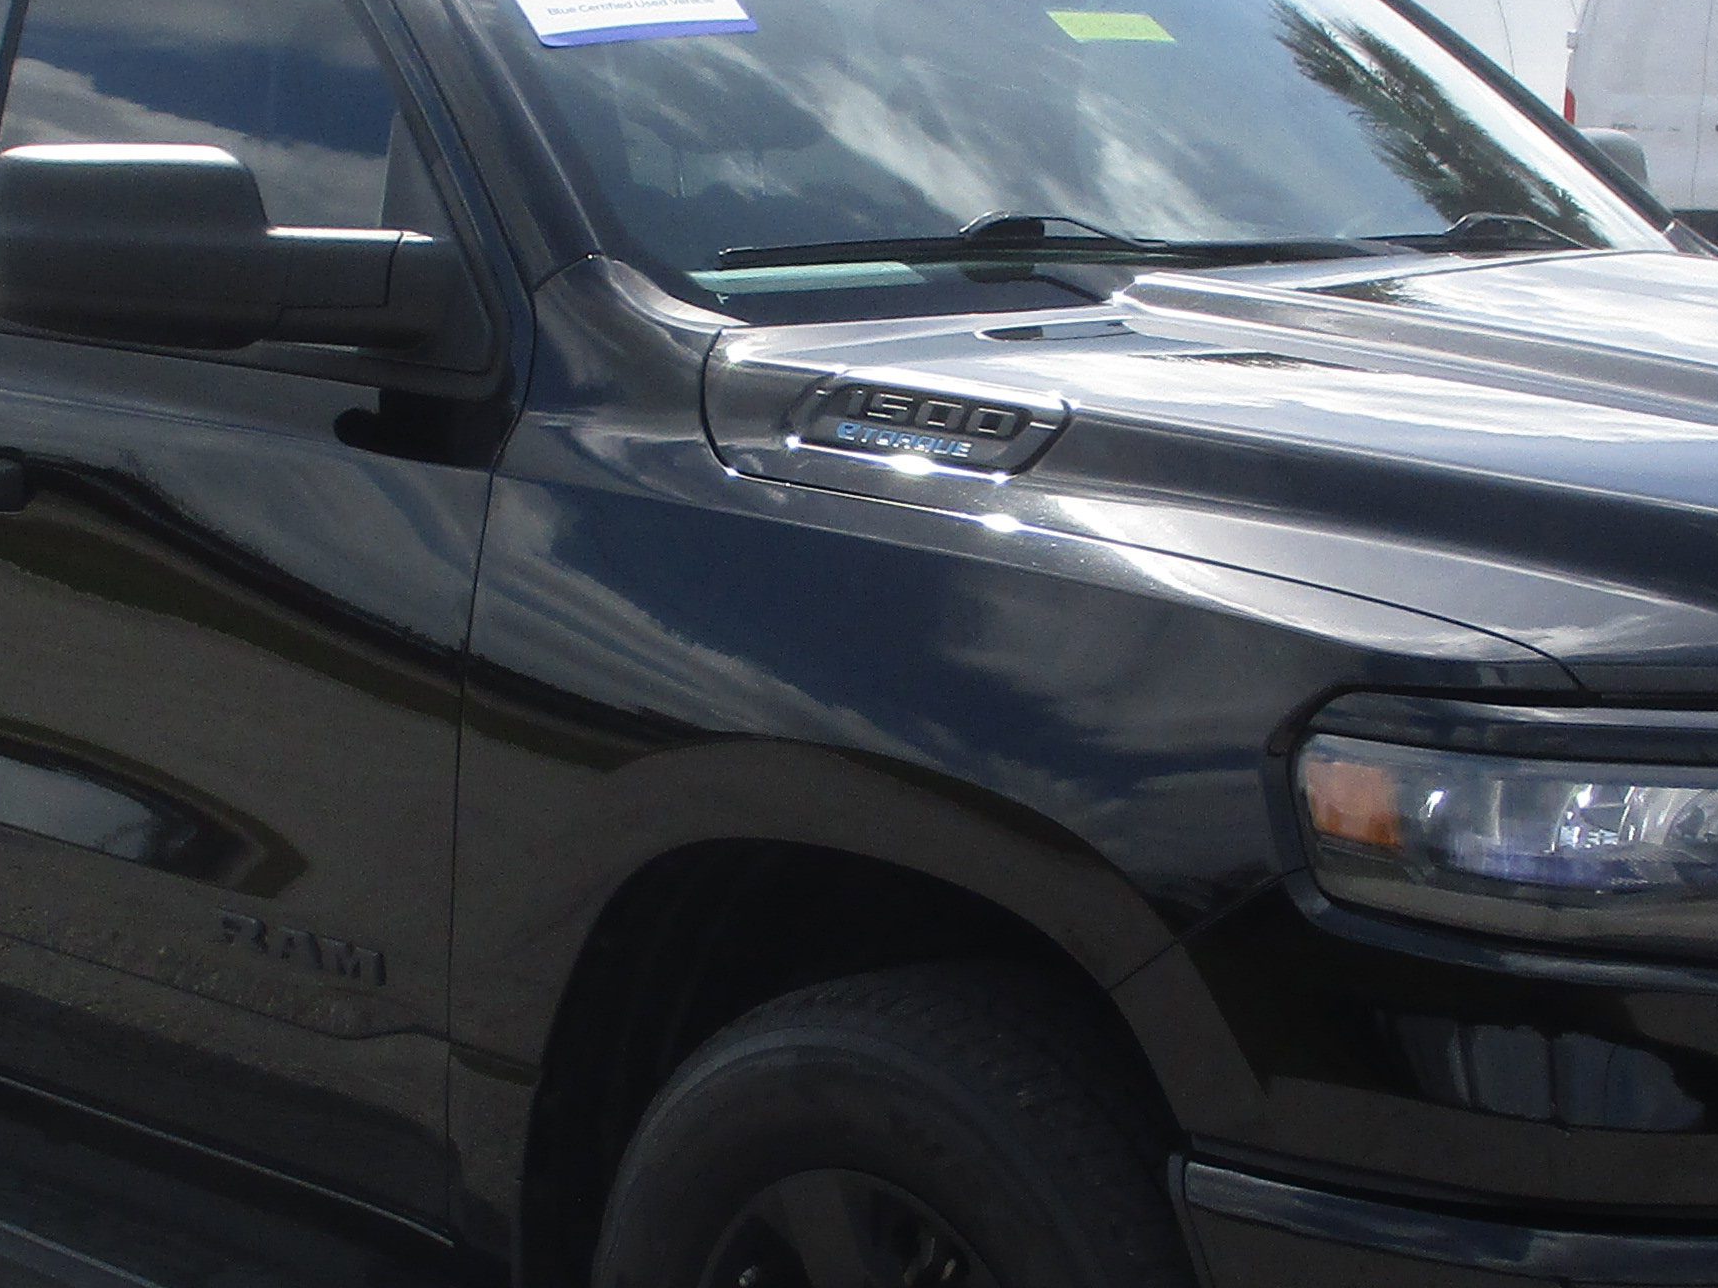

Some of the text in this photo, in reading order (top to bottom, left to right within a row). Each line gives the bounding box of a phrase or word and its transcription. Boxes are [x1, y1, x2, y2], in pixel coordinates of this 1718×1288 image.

[547, 6, 577, 16] Blue
[578, 0, 633, 13] Certified
[846, 389, 1019, 437] 1500
[212, 909, 387, 987] RAM
